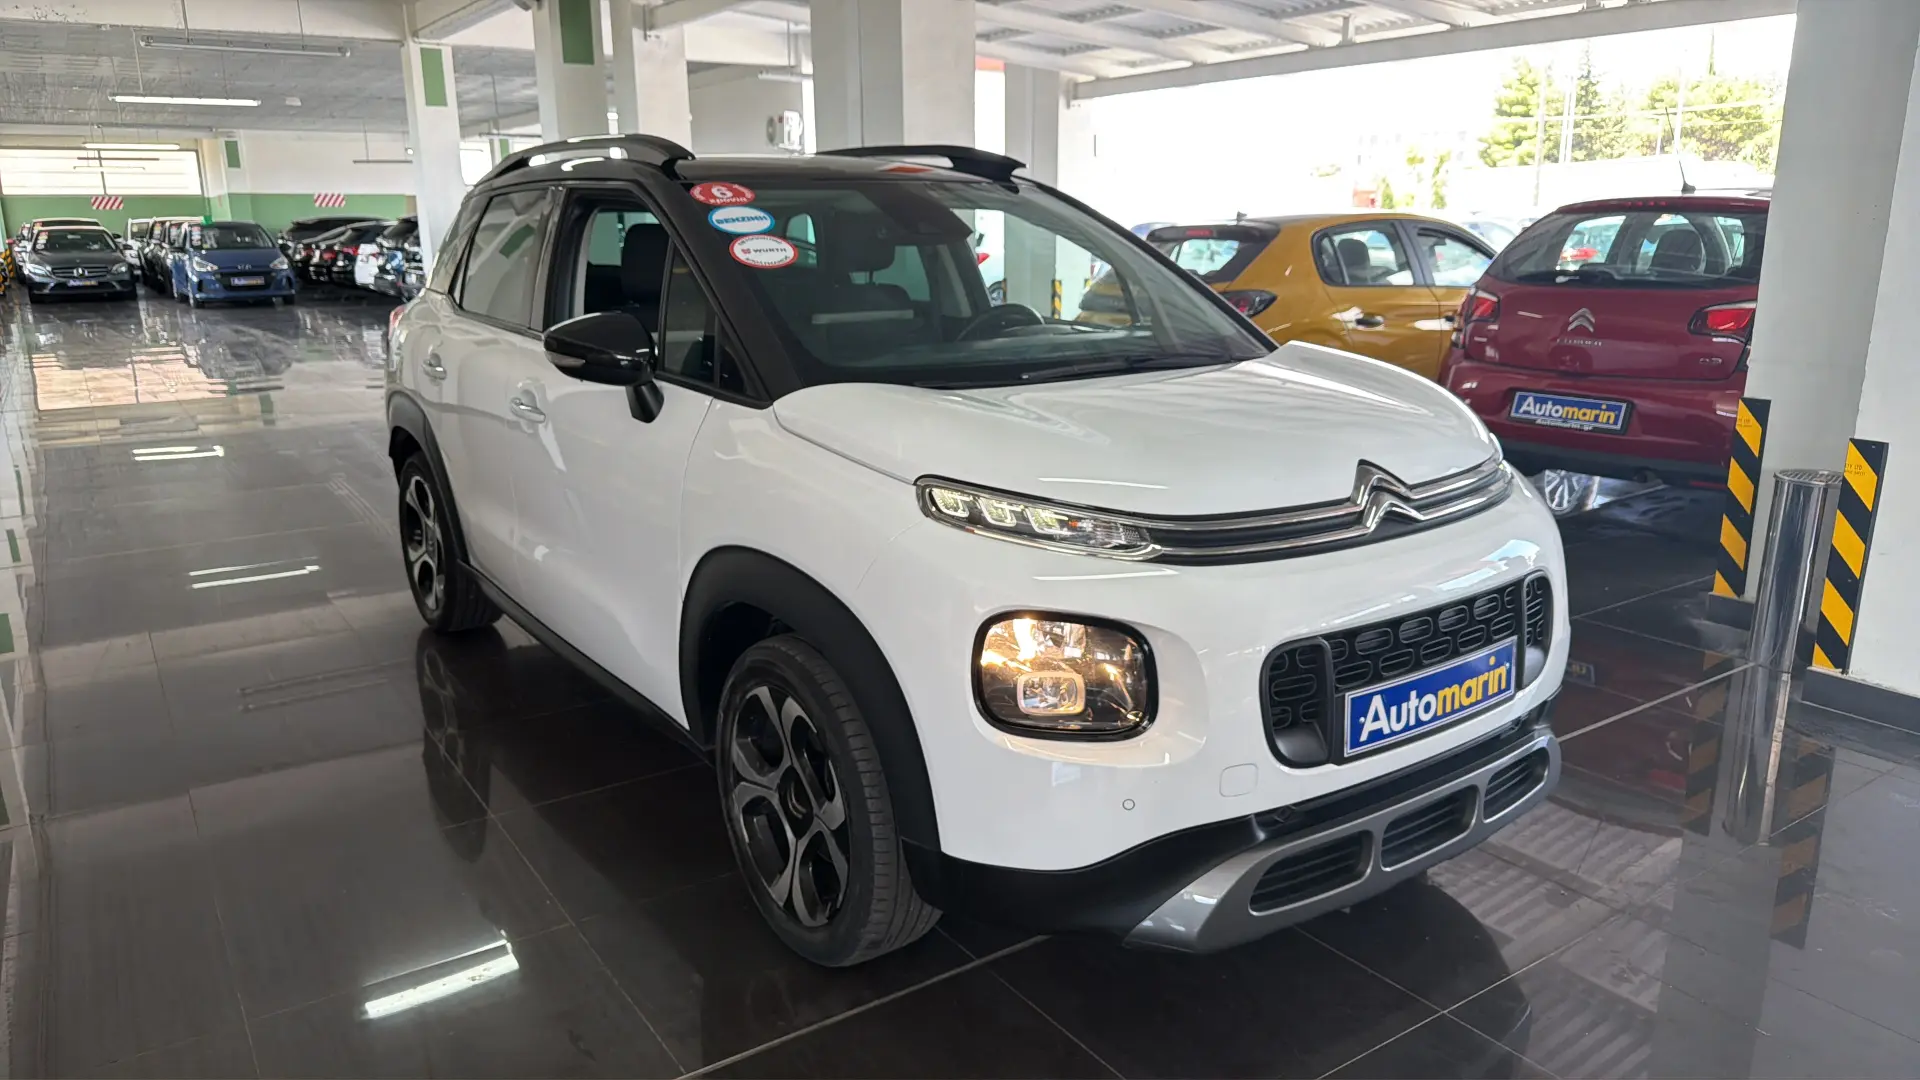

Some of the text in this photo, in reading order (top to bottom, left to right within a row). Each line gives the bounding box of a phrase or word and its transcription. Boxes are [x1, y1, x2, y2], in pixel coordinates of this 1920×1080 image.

[711, 184, 733, 199] 6
[1518, 396, 1616, 425] Automarin
[1359, 655, 1507, 742] Automarin
